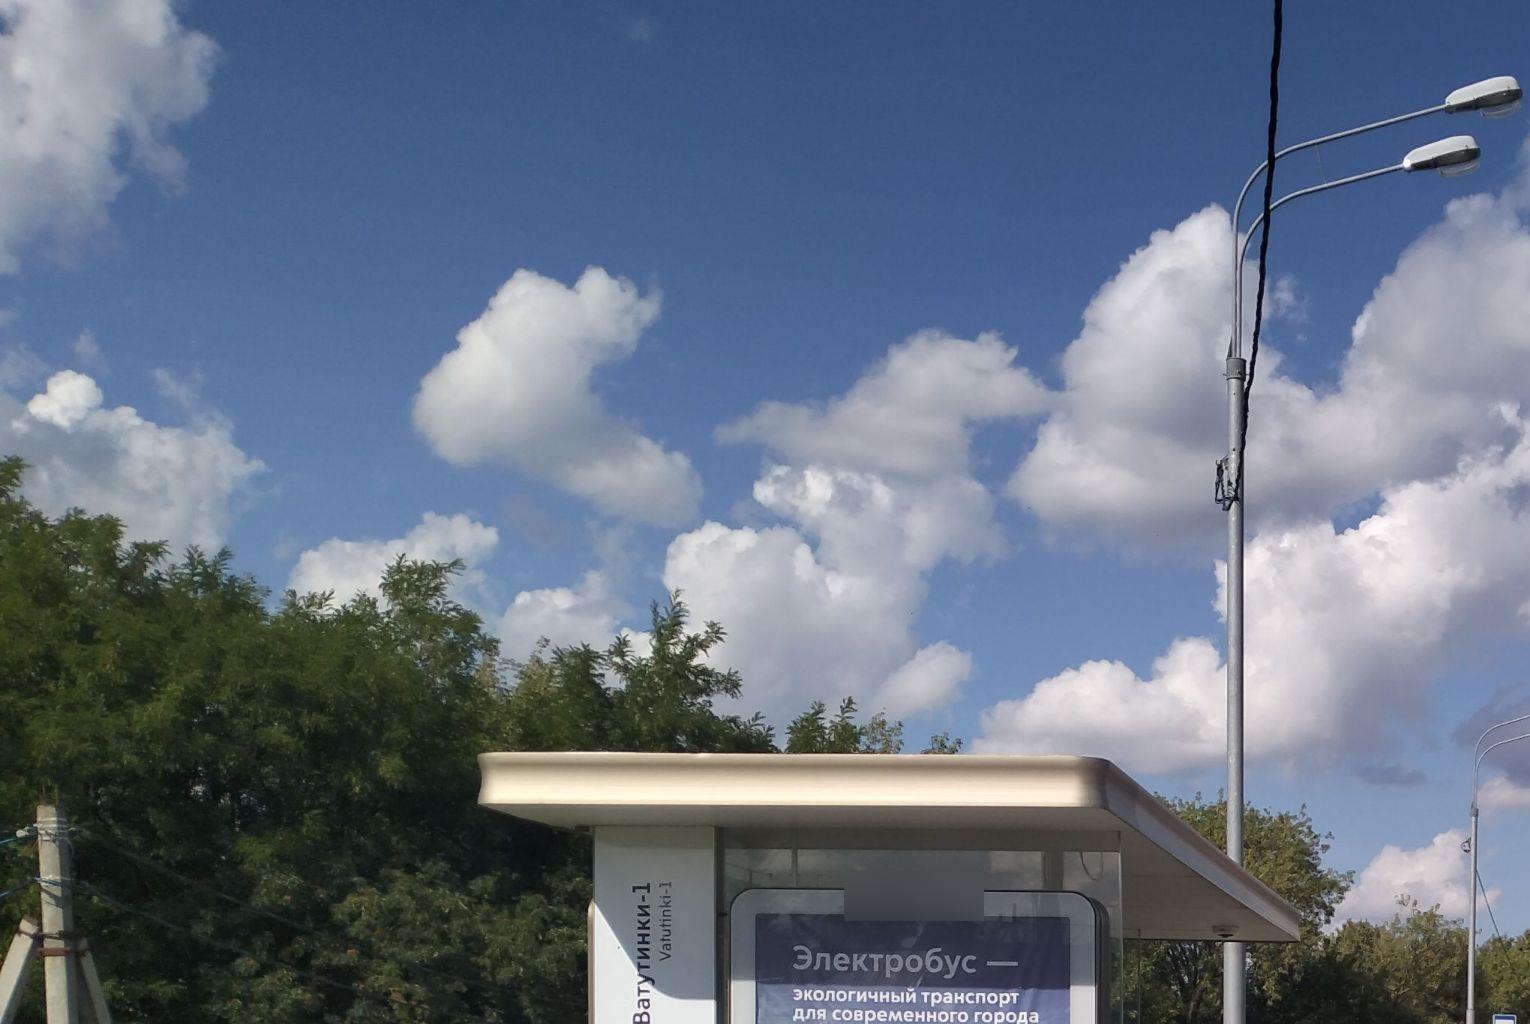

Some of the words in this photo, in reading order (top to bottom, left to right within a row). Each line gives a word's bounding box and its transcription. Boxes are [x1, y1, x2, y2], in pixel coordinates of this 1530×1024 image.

[658, 881, 672, 962] Vatutinki-1
[792, 945, 977, 979] Электробус
[793, 988, 917, 1004] экологичный
[921, 991, 1020, 1007] транспорт
[793, 1007, 827, 1022] для
[832, 1007, 969, 1024] современного
